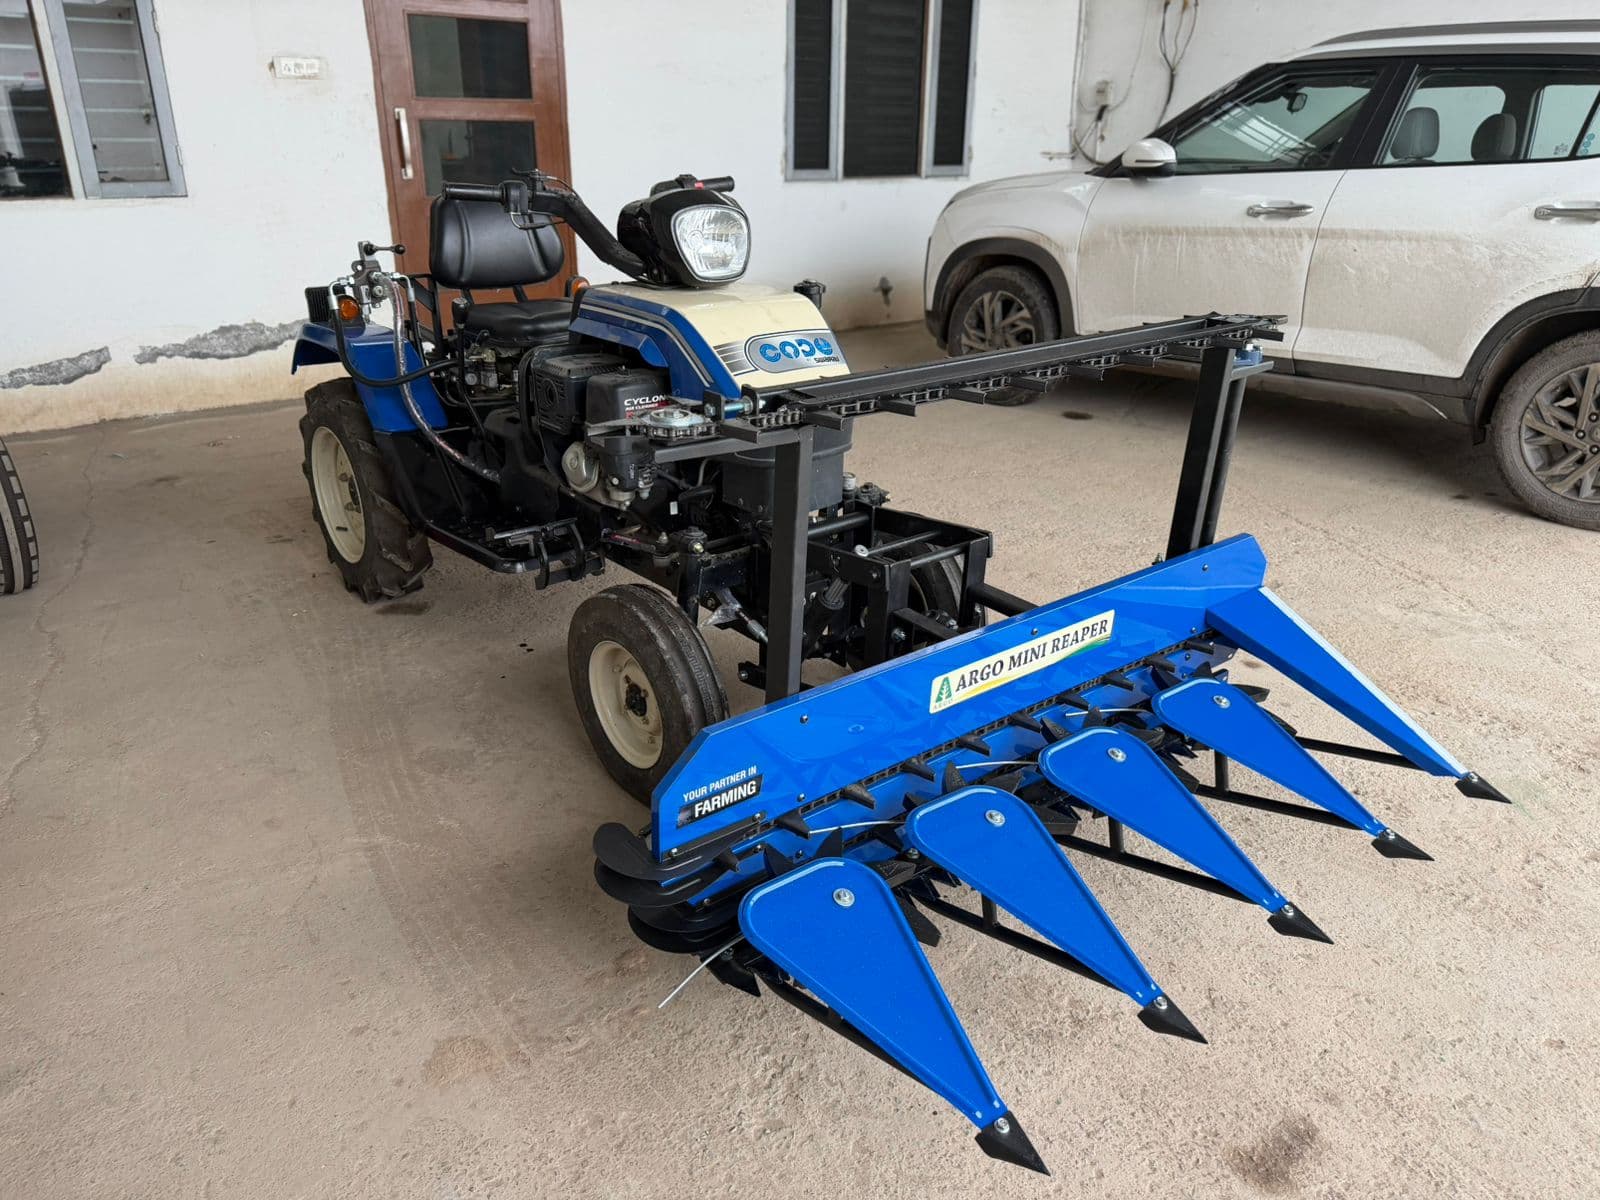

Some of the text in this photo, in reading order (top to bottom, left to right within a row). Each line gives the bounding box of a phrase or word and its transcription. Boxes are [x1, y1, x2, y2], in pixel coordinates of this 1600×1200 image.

[624, 394, 668, 406] CYCLON
[955, 619, 1108, 692] ARGO MINI REAPER
[683, 765, 757, 802] YOUR PARTNER IN
[694, 780, 757, 818] FARMING
